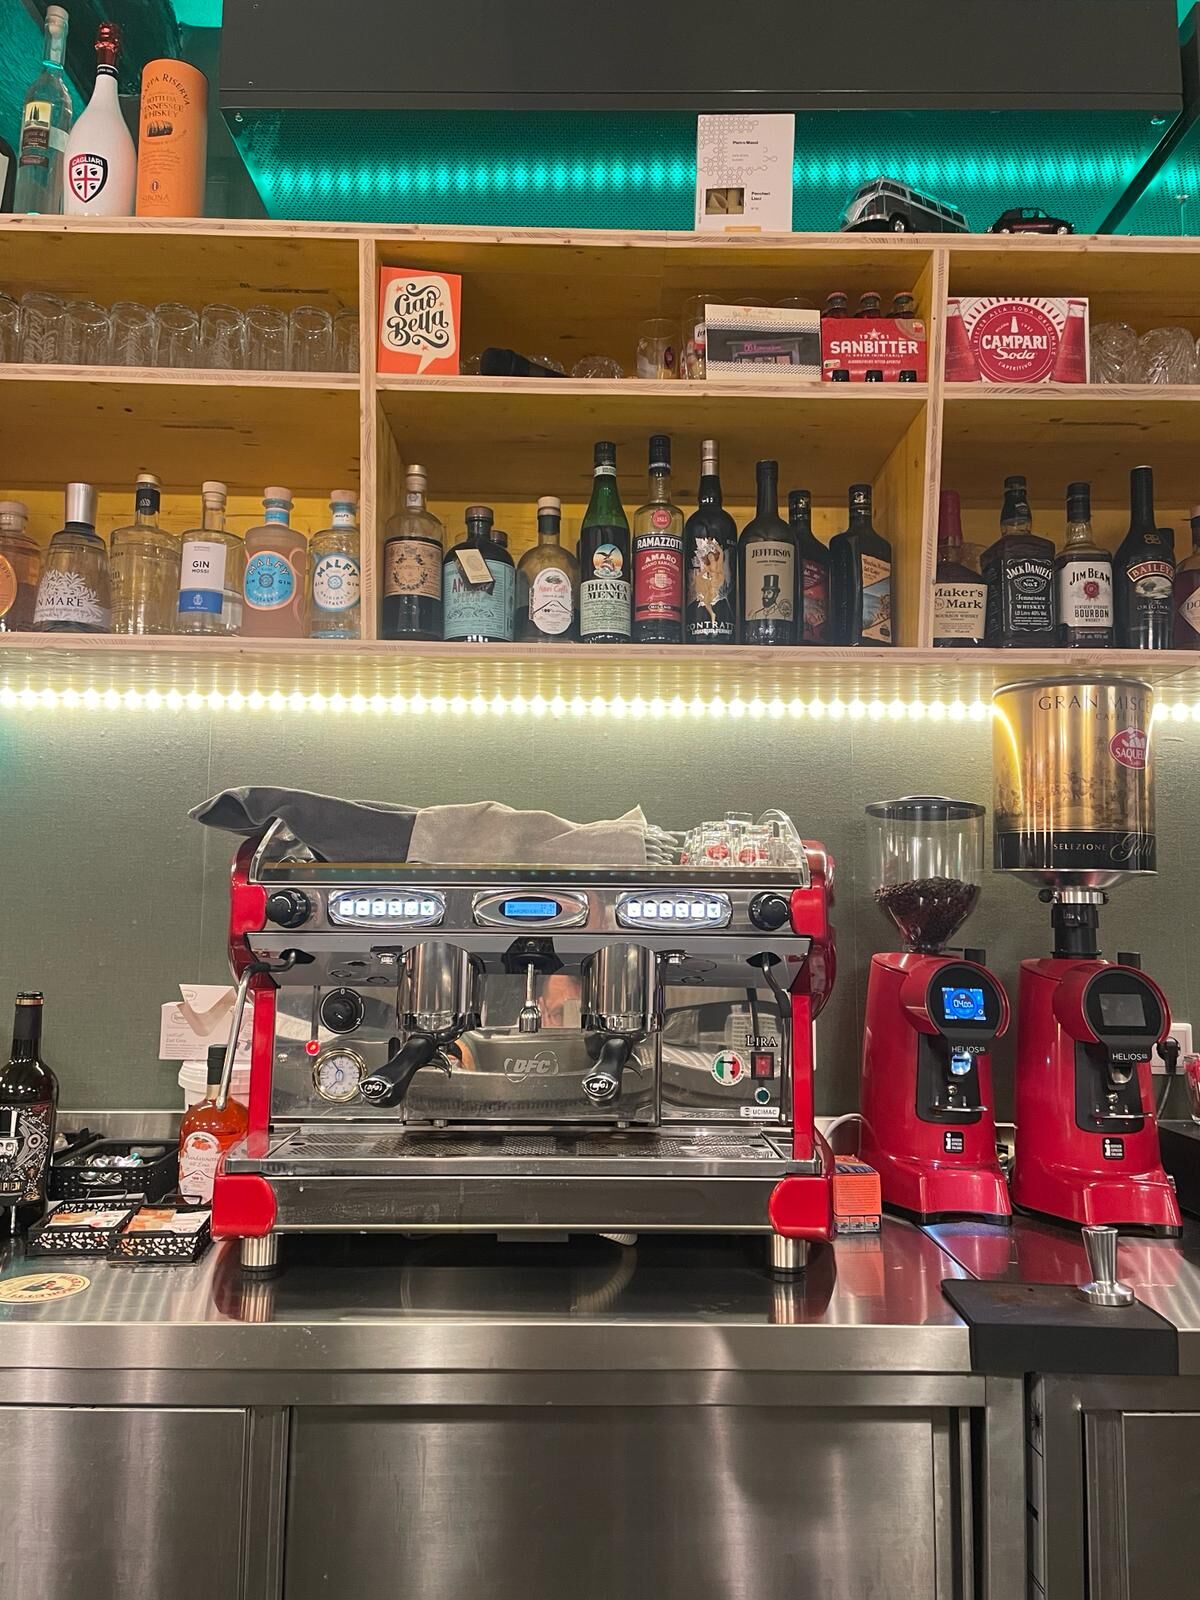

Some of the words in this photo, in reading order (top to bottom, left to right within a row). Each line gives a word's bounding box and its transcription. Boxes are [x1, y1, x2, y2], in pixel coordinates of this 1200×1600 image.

[162, 73, 192, 107] RISERVA
[71, 155, 104, 167] CAGLIARI
[394, 285, 441, 317] Ciao
[386, 310, 449, 348] Bella
[989, 306, 1008, 318] ALLA
[1012, 305, 1034, 315] SODA
[1037, 315, 1057, 356] ORIGINALE
[982, 335, 1048, 350] CAMPARI
[992, 346, 1036, 360] Soda
[645, 553, 677, 565] AMARO
[751, 548, 791, 559] JEFFERSON
[192, 560, 210, 569] GIN
[248, 558, 289, 575] MALFY
[316, 559, 359, 578] MALFY
[1006, 565, 1025, 580] JACK
[1070, 570, 1087, 586] JIM
[1087, 567, 1111, 586] BEAM
[587, 582, 628, 593] BRANCA
[935, 587, 984, 598] Maker's
[587, 591, 628, 601] MENTA
[945, 599, 984, 609] Mark
[1074, 609, 1109, 618] BOURBON
[1038, 695, 1098, 712] GRAN
[1053, 843, 1107, 851] SELEZIONE
[1109, 832, 1153, 862] Gold
[340, 988, 346, 996] 0
[355, 1017, 362, 1025] 2
[745, 1034, 778, 1047] LIRA
[951, 1045, 979, 1054] HELIOS
[1112, 1052, 1142, 1062] HELIOS
[752, 1108, 777, 1116] UCIMAC
